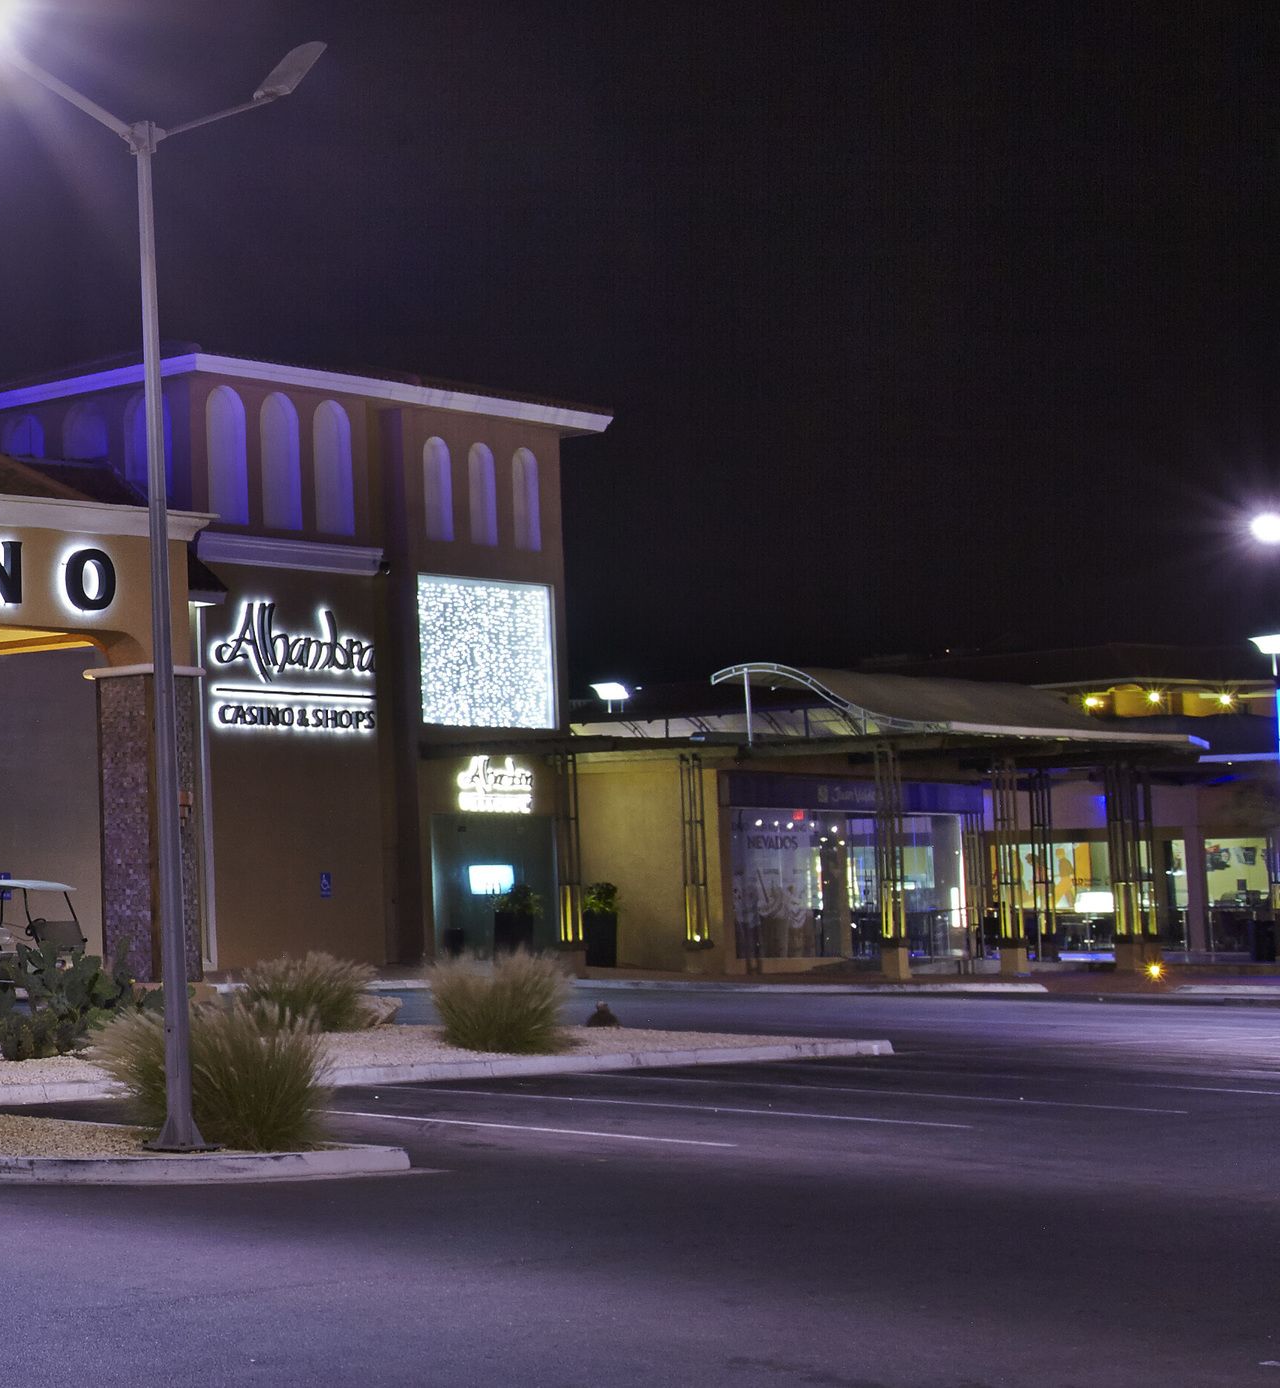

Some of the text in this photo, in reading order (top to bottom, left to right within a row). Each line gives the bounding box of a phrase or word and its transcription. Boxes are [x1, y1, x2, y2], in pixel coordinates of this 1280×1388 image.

[215, 603, 375, 683] Alhambra
[218, 704, 376, 730] CASINO & SHOPS
